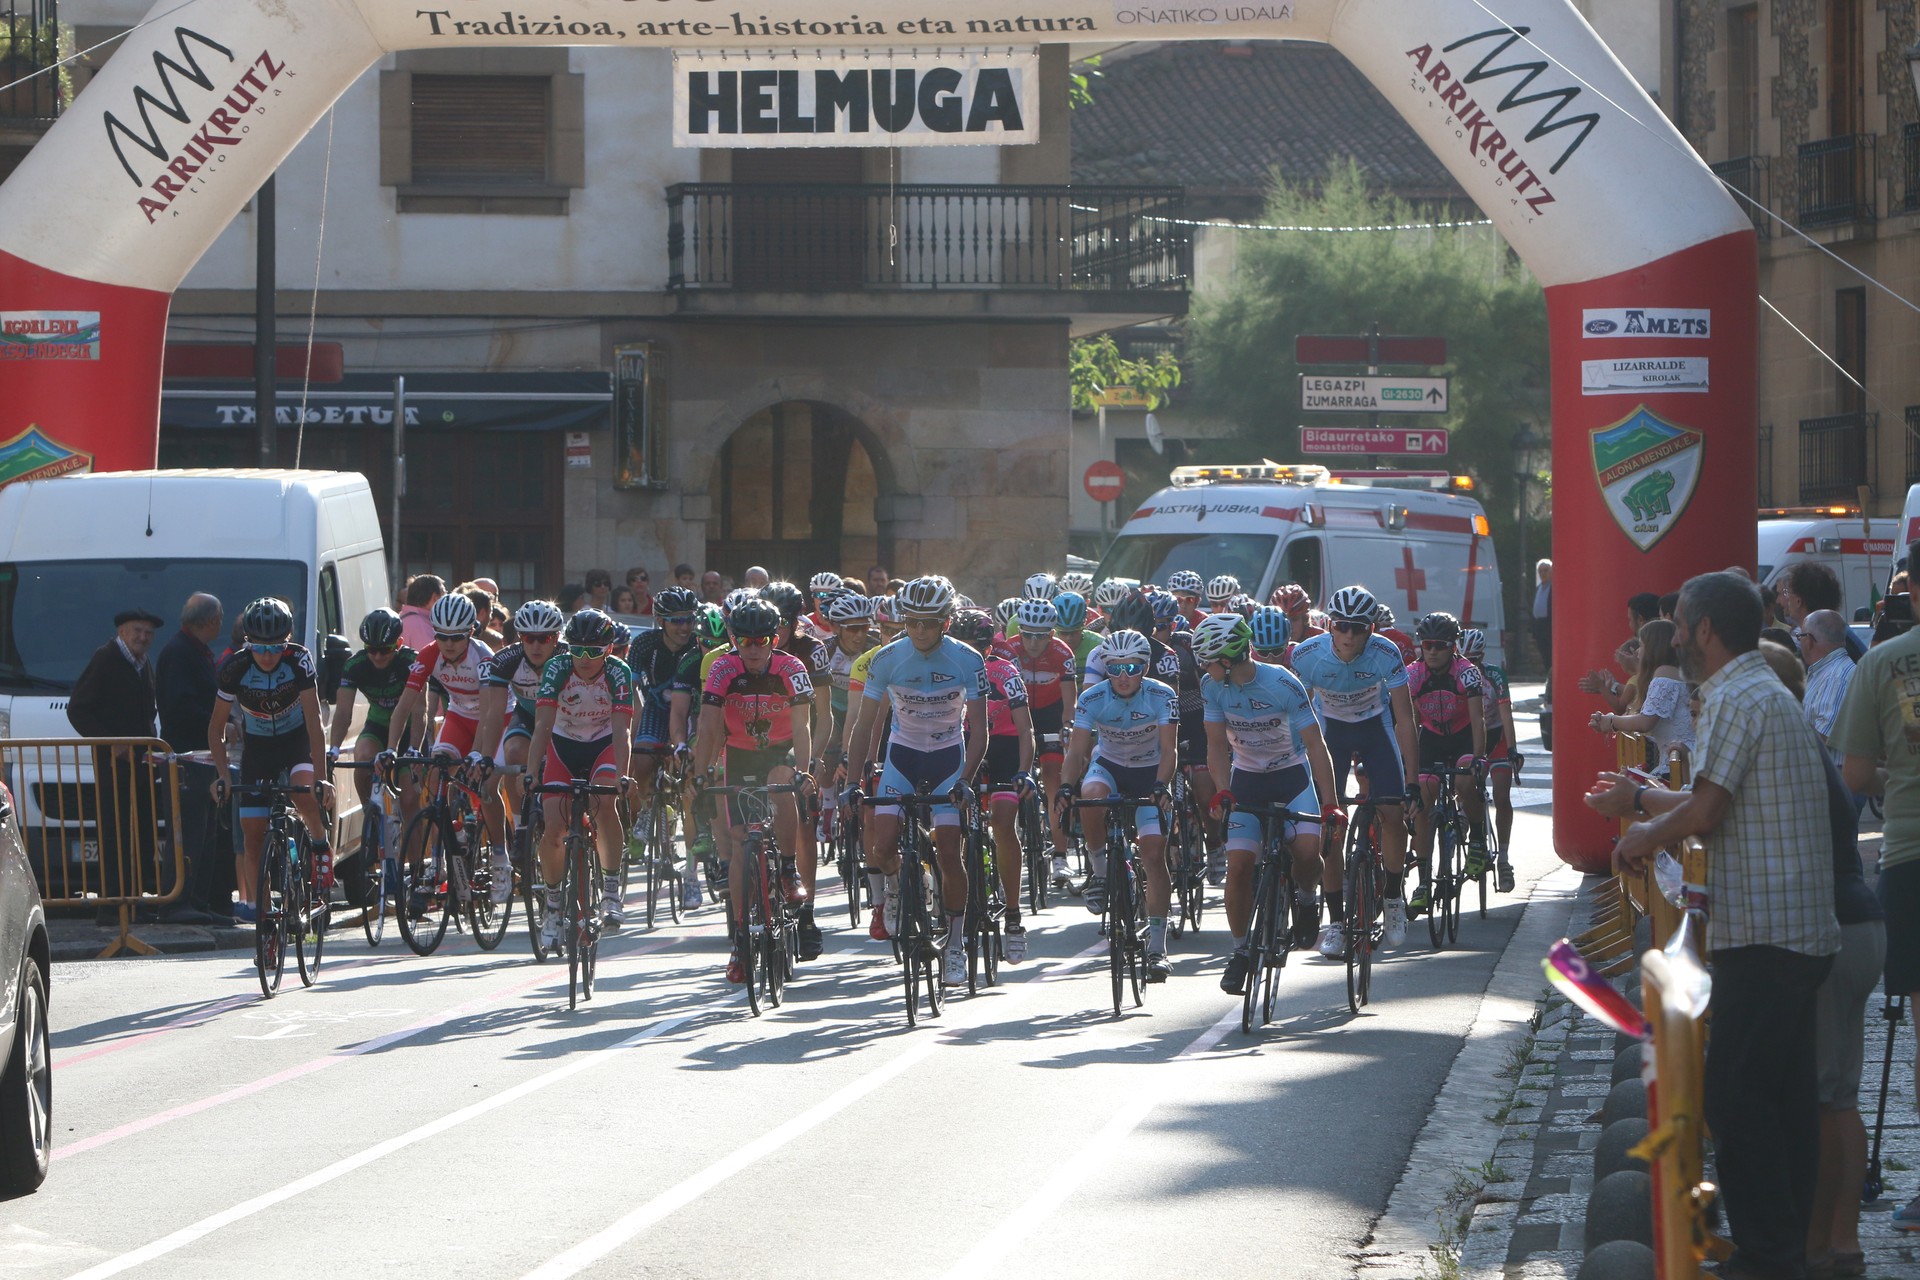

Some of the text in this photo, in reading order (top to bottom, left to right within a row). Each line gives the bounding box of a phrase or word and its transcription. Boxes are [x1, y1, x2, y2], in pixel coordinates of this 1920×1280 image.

[1116, 4, 1292, 24] OÑATIKO UDALA
[416, 9, 1098, 39] Tradizioa, arte-historia eta natura
[688, 67, 1025, 134] HELMUGA
[136, 49, 286, 225] ARRIKRUTZ
[1405, 42, 1557, 216] ARRIKRUTZ
[1613, 360, 1686, 372] LIZARRALDE
[1306, 380, 1365, 391] LEGAZPI
[1642, 374, 1681, 382] KIROLAK
[1306, 396, 1377, 407] ZUMARRAGA
[1382, 388, 1422, 400] GI-2630
[1306, 430, 1395, 443] Bidaurretako
[1306, 443, 1366, 451] monasterioa
[1606, 460, 1641, 482] ALOÑA
[1641, 446, 1674, 466] MENDI
[1461, 668, 1481, 688] 233
